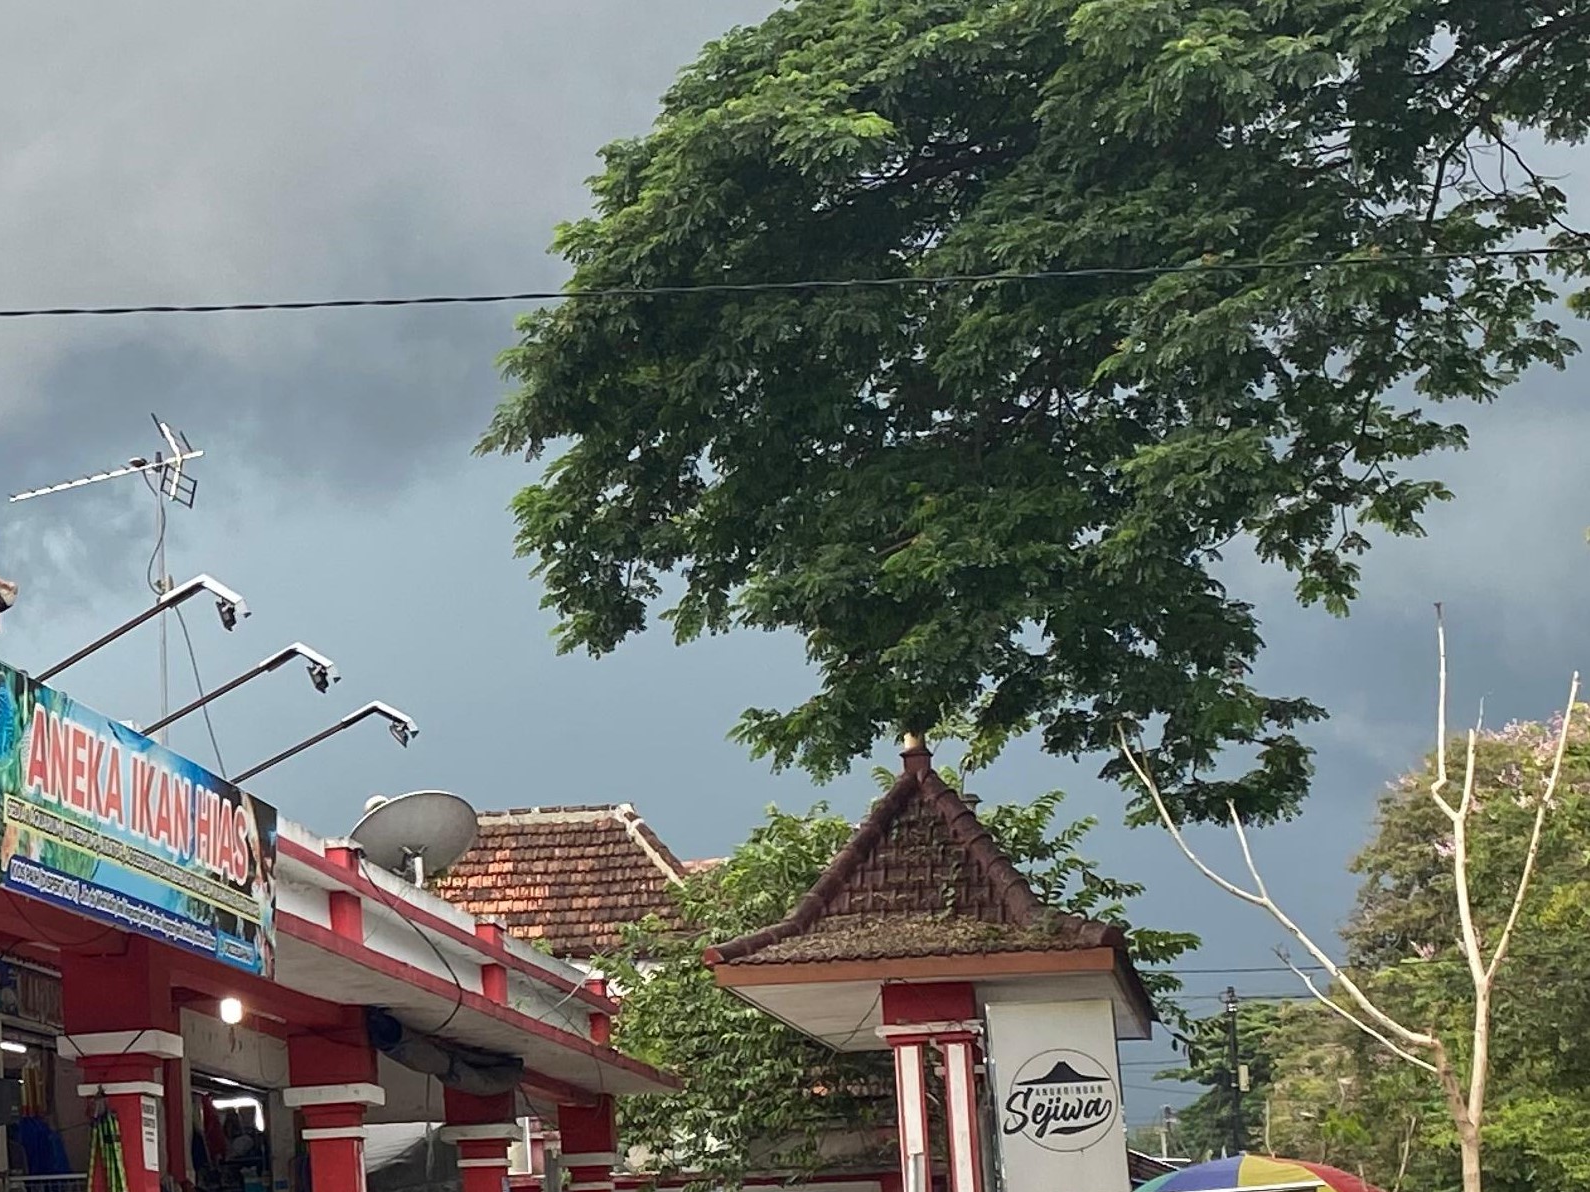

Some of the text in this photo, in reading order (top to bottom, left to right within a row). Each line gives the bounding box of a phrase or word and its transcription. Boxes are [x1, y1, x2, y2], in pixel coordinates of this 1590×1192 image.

[25, 702, 126, 828] ANEKA
[130, 750, 192, 861] IKAN
[195, 783, 249, 887] HIAS
[1003, 1087, 1112, 1139] Sejiwa
